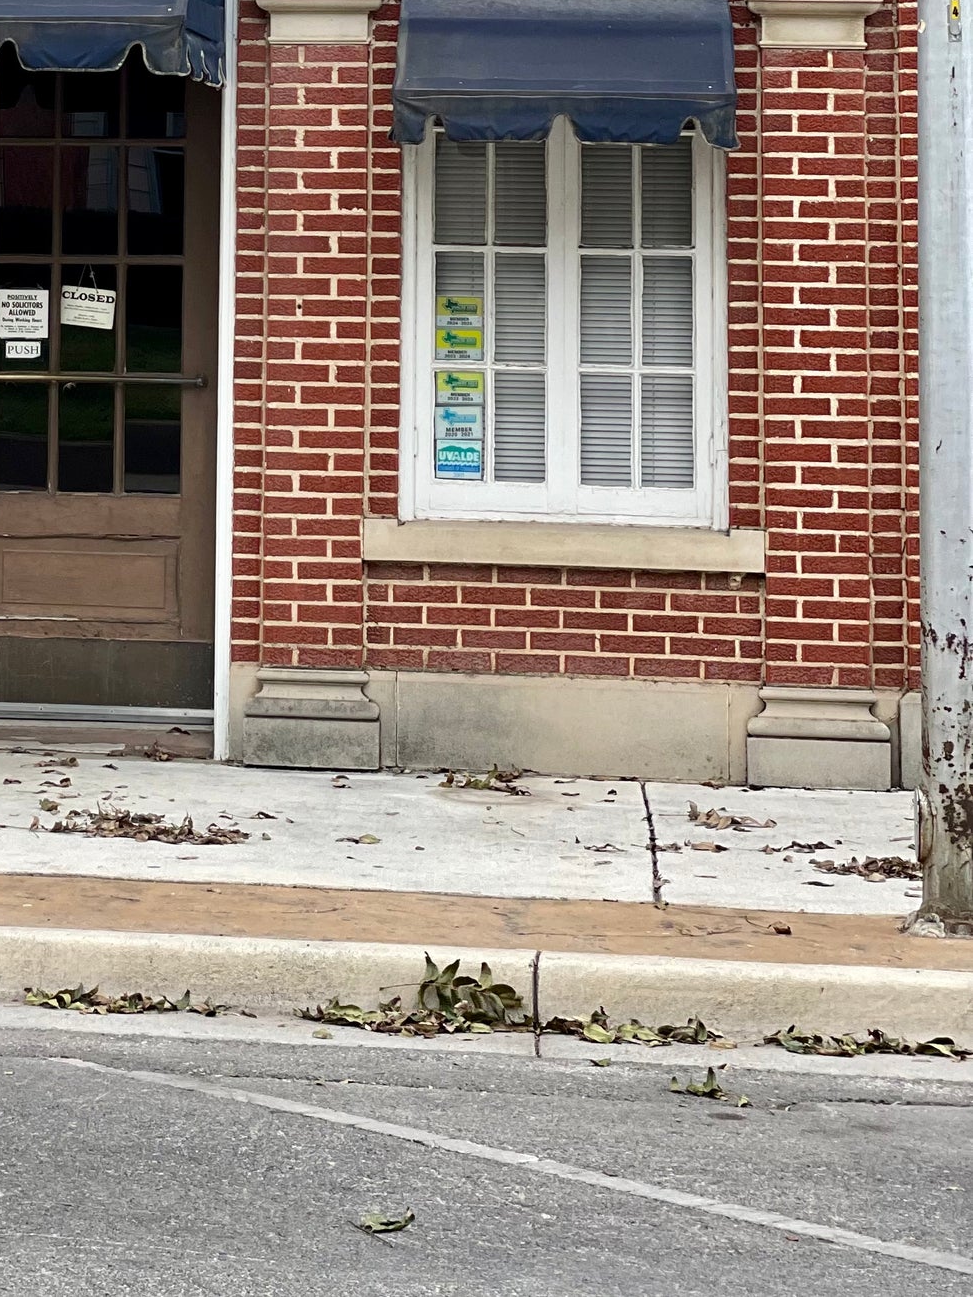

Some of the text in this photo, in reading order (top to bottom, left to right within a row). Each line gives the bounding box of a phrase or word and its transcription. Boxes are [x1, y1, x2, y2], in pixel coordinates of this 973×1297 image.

[62, 291, 115, 304] CLOSED
[7, 344, 39, 355] PUSH
[438, 451, 480, 462] UVALDE
